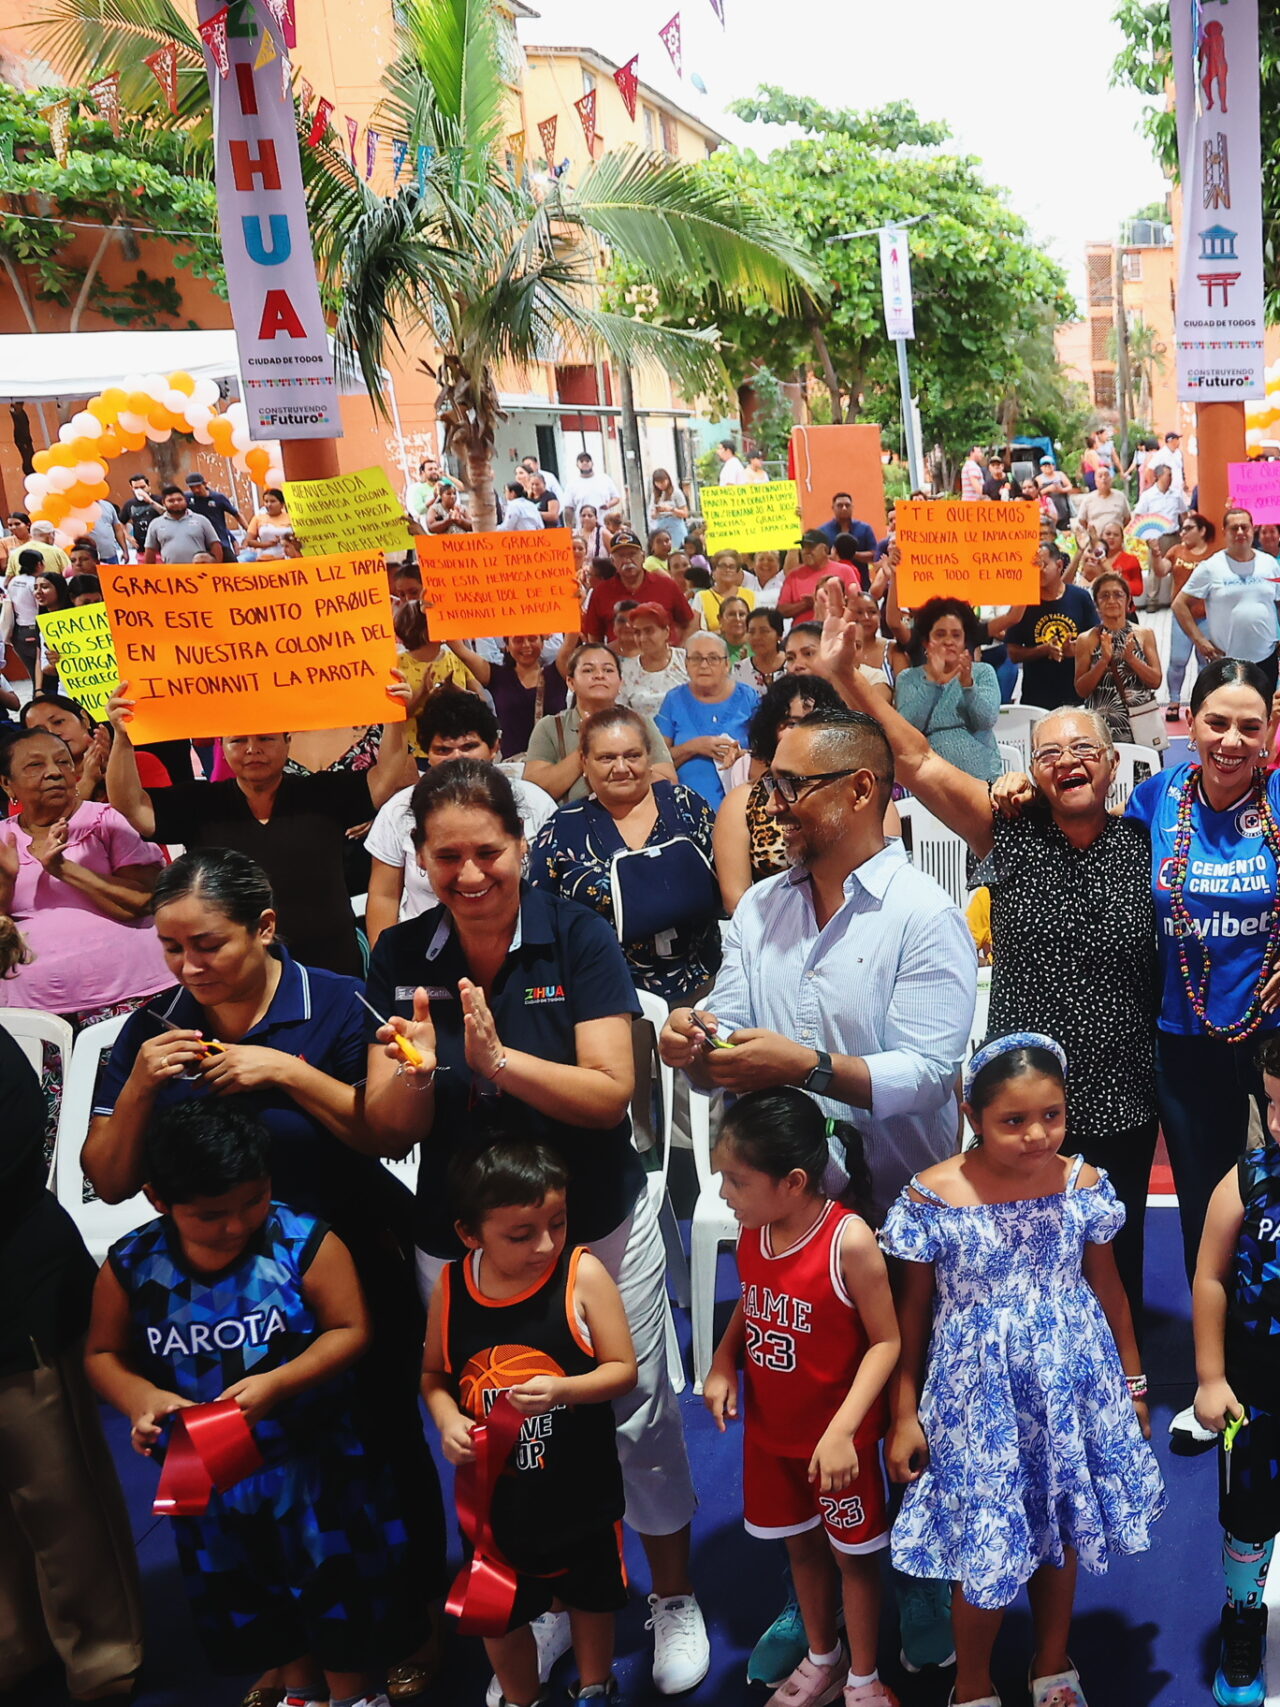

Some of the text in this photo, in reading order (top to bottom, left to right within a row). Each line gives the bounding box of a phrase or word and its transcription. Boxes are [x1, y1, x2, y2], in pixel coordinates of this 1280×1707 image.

[1183, 319, 1215, 327] CIUDAD
[1216, 319, 1227, 327] DE
[248, 355, 323, 365] CIUDAD DE TODOS
[1187, 368, 1254, 376] CONSTRUYENDO
[1198, 376, 1244, 387] Futuro
[259, 404, 328, 414] CONSTRUYENDO
[270, 413, 319, 425] Futuro
[291, 476, 366, 498] BIENVENIDA
[307, 499, 350, 513] HERMOSA
[354, 488, 389, 503] COLONIA
[337, 513, 351, 521] LA
[354, 503, 391, 519] PAROTA
[442, 535, 551, 552] MUCHAS GRACIAS
[900, 530, 1037, 543] PRESIDENTA LIZ TAPIA CASTRO
[484, 556, 497, 567] LIZ
[505, 553, 531, 566] TAPIA
[910, 551, 1022, 565] MUCHAS GRACIAS
[112, 575, 199, 598] GRACIAS
[316, 565, 346, 582] LIZ
[426, 567, 572, 587] POR ESTA HERMOSA CANCHA
[913, 569, 1023, 582] POR TODO EL APOYO
[432, 593, 445, 603] DE
[551, 585, 565, 595] EL
[114, 587, 382, 629] POR ESTE BONITO PARQUE
[438, 601, 561, 621] INFONAVIT LA PAROTA
[53, 641, 81, 655] LOS
[127, 624, 391, 665] EN NUESTRA COLONIA DEL
[140, 660, 375, 699] INFONAVIT LA PAROTA
[1191, 855, 1267, 877] CEMENTO
[1189, 875, 1270, 892] CRUZ AZUL
[525, 985, 565, 1000] ZIHUA
[147, 1308, 286, 1356] PAROTA
[745, 1319, 796, 1373] 23
[520, 1414, 553, 1441] IVE
[516, 1441, 545, 1470] UP
[819, 1495, 866, 1529] 23
